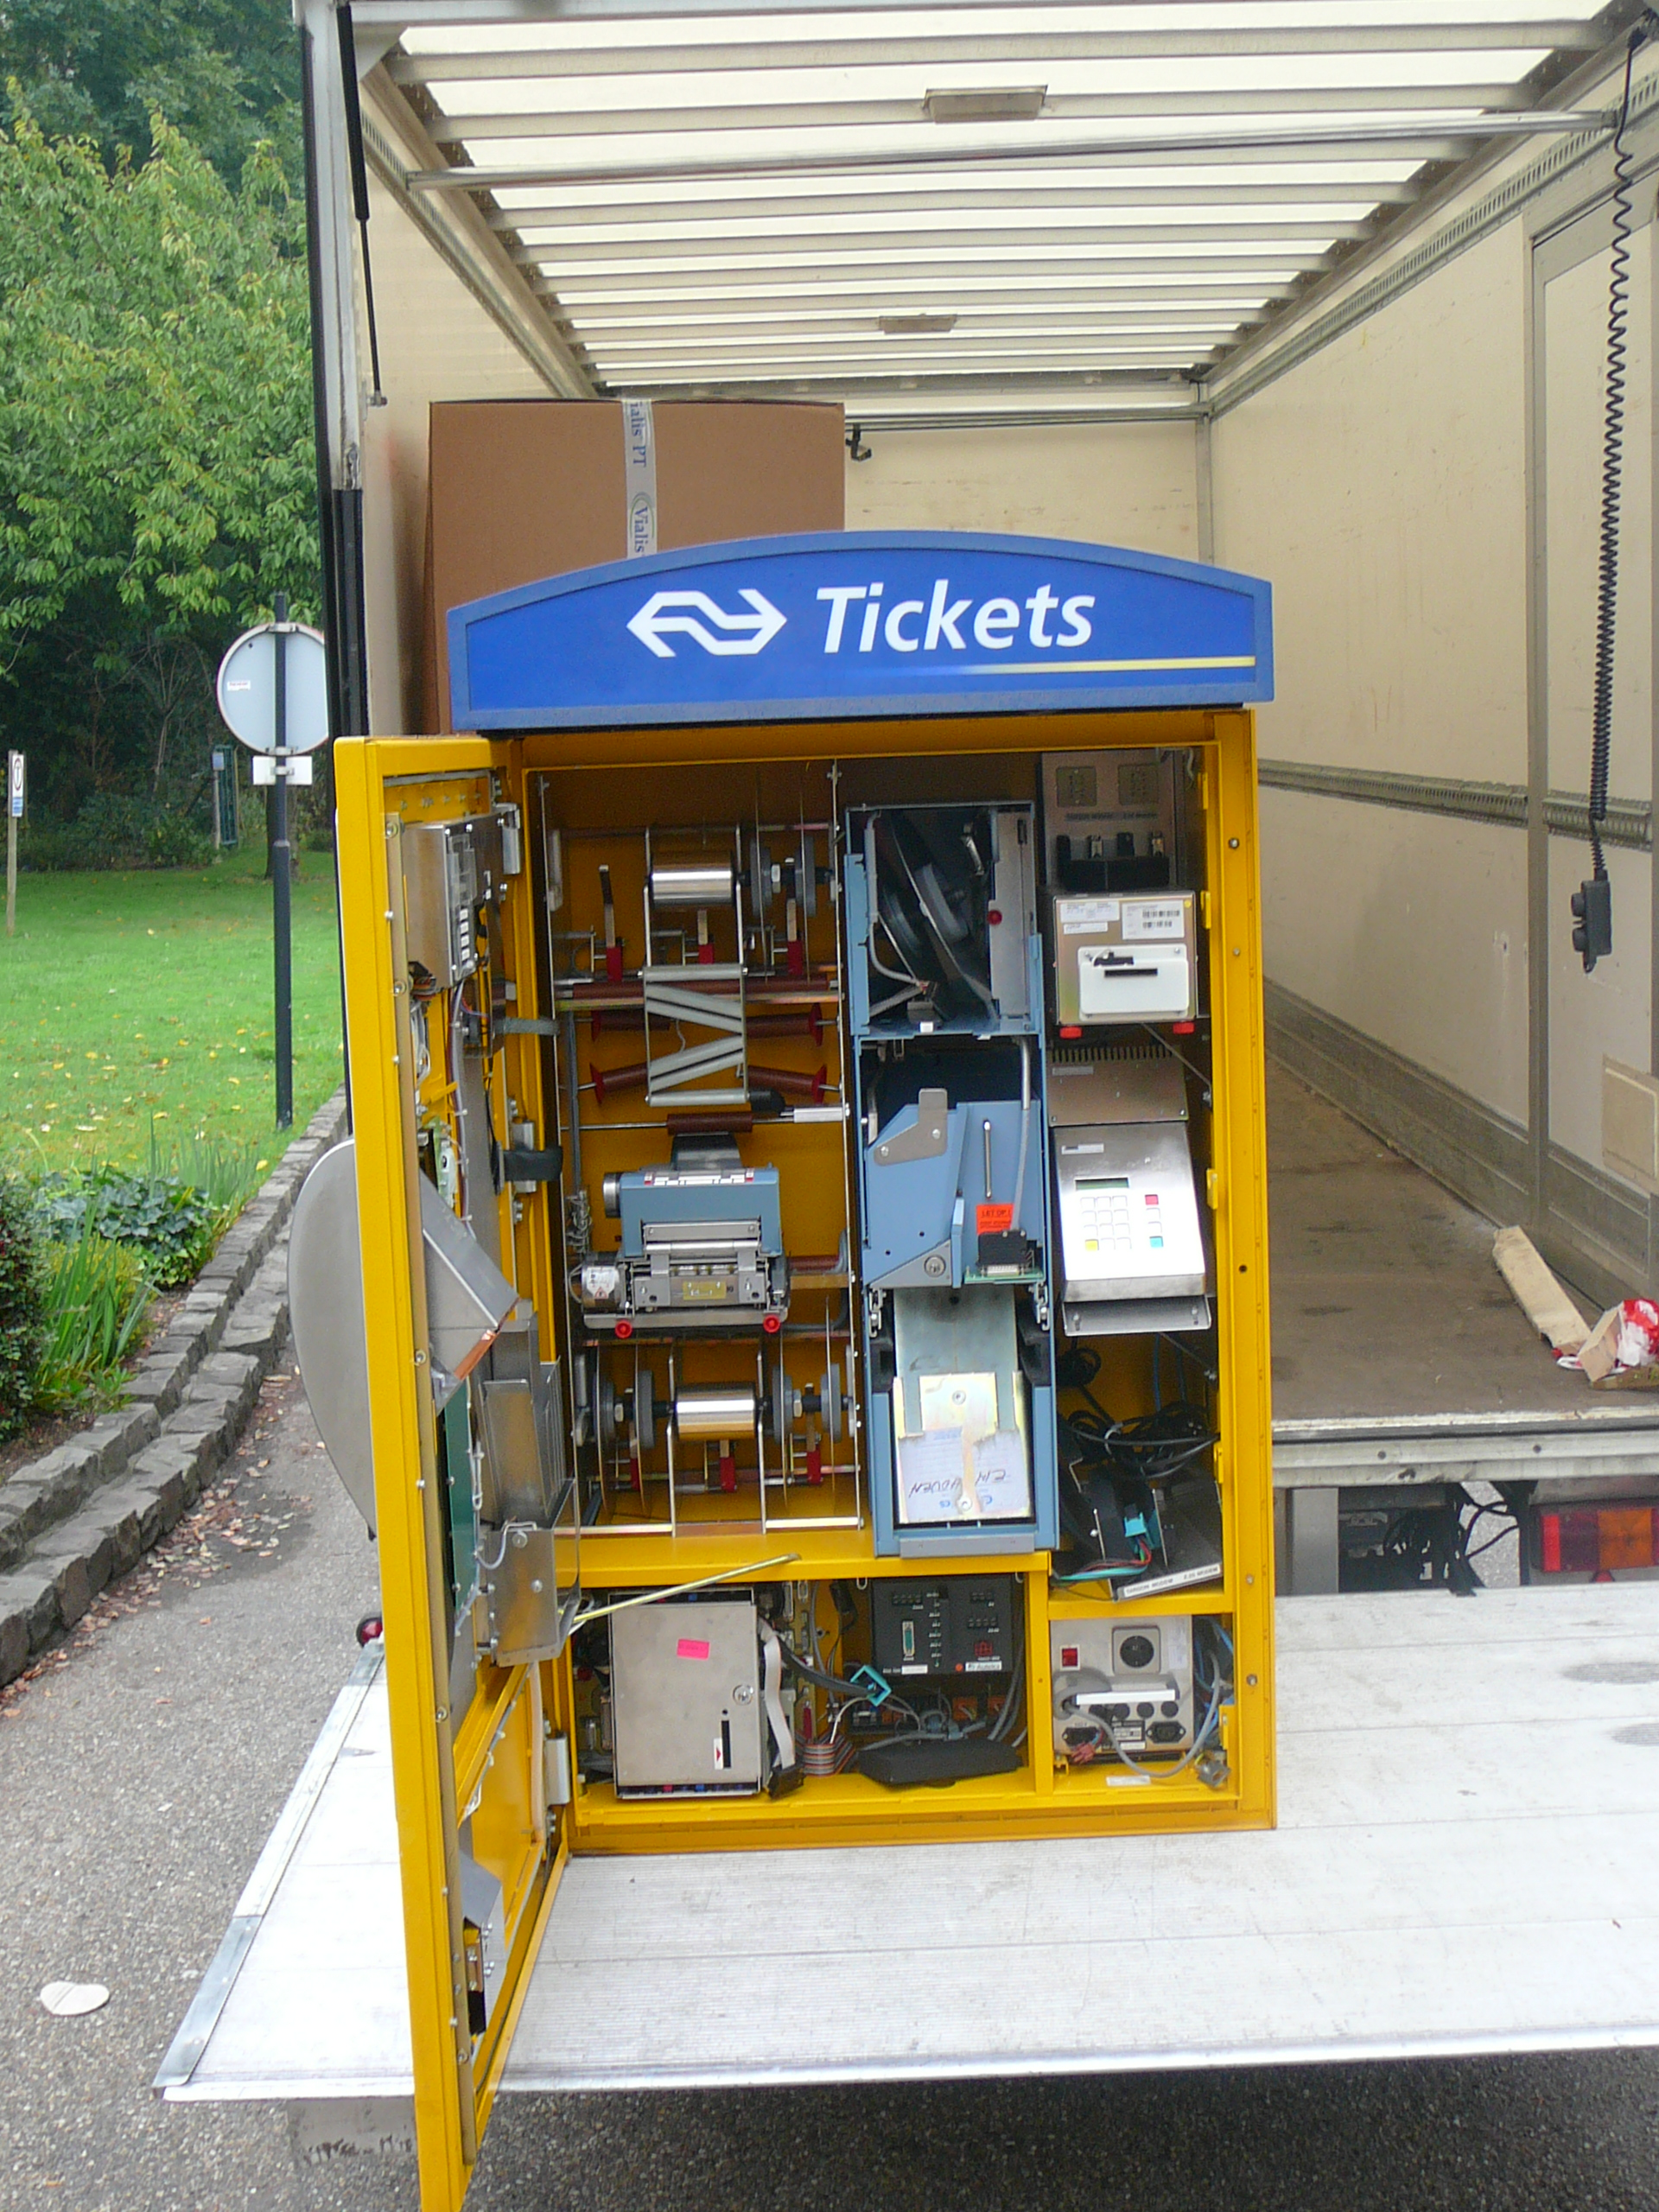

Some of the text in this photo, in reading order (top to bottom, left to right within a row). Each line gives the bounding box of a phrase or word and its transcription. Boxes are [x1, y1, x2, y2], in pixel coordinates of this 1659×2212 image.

[631, 400, 646, 467] ialis PT
[634, 506, 648, 553] Vialis
[816, 579, 1096, 653] Tickets
